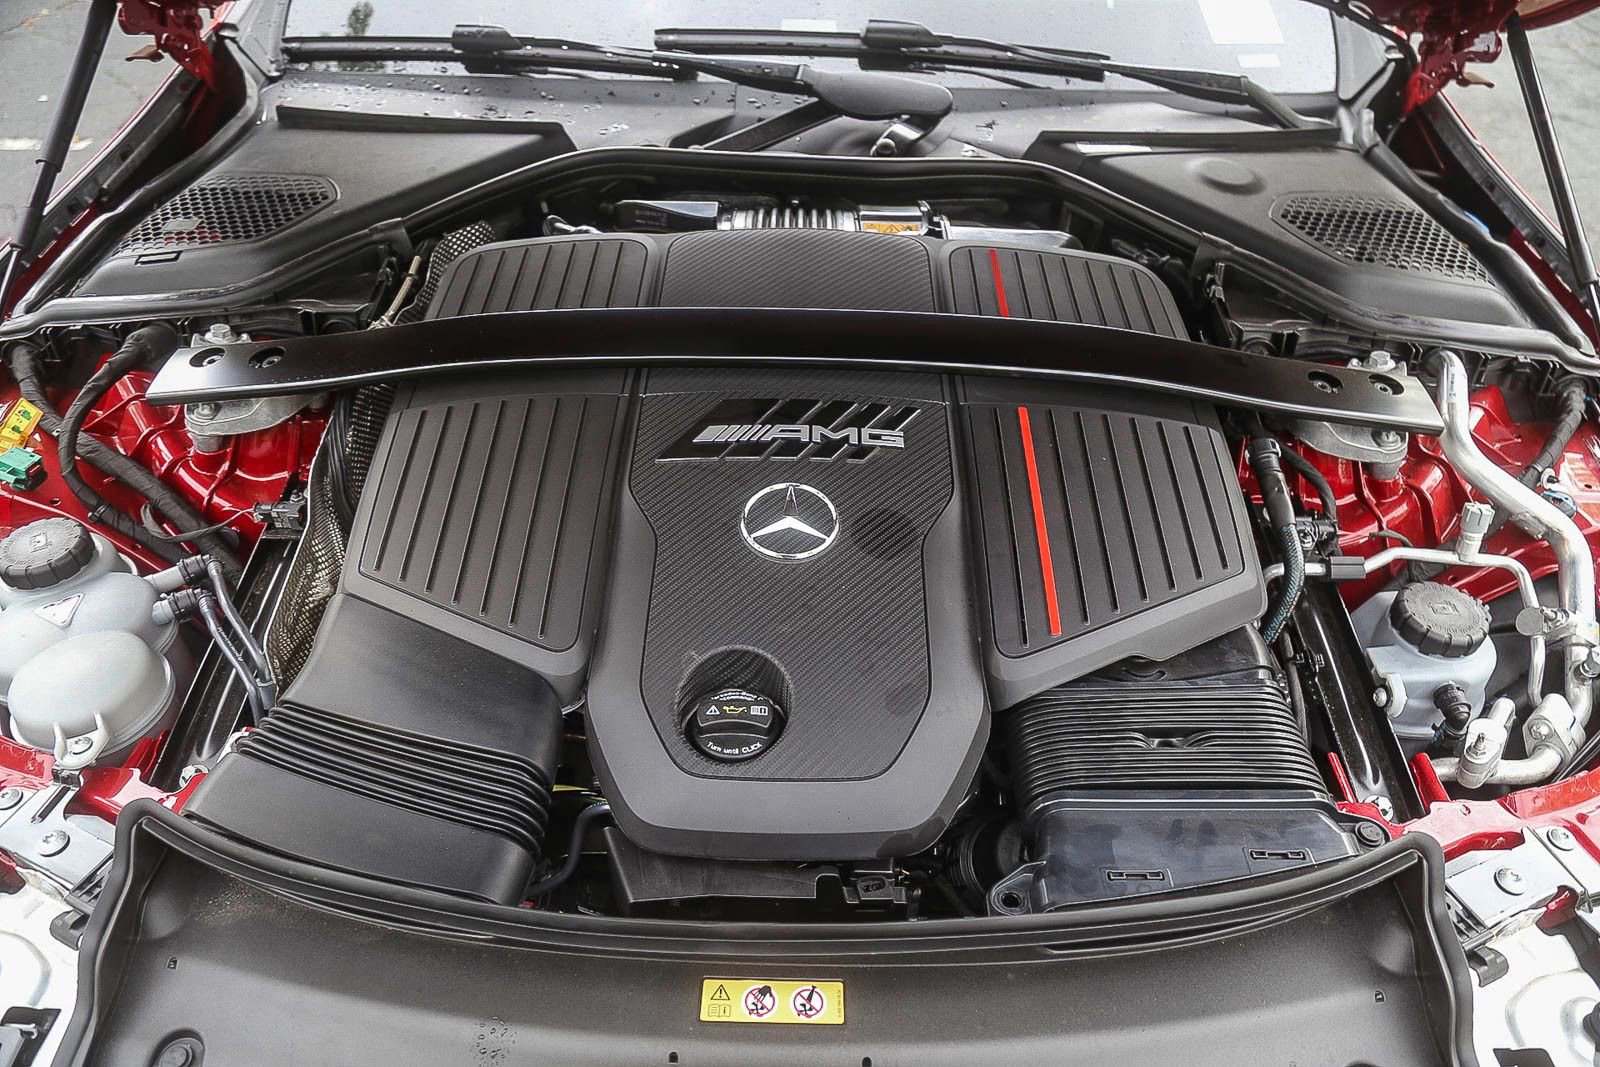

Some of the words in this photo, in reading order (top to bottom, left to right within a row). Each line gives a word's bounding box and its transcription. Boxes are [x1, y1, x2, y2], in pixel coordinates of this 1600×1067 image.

[760, 424, 905, 448] AMG
[707, 741, 722, 752] Turn
[741, 741, 763, 753] CLICK
